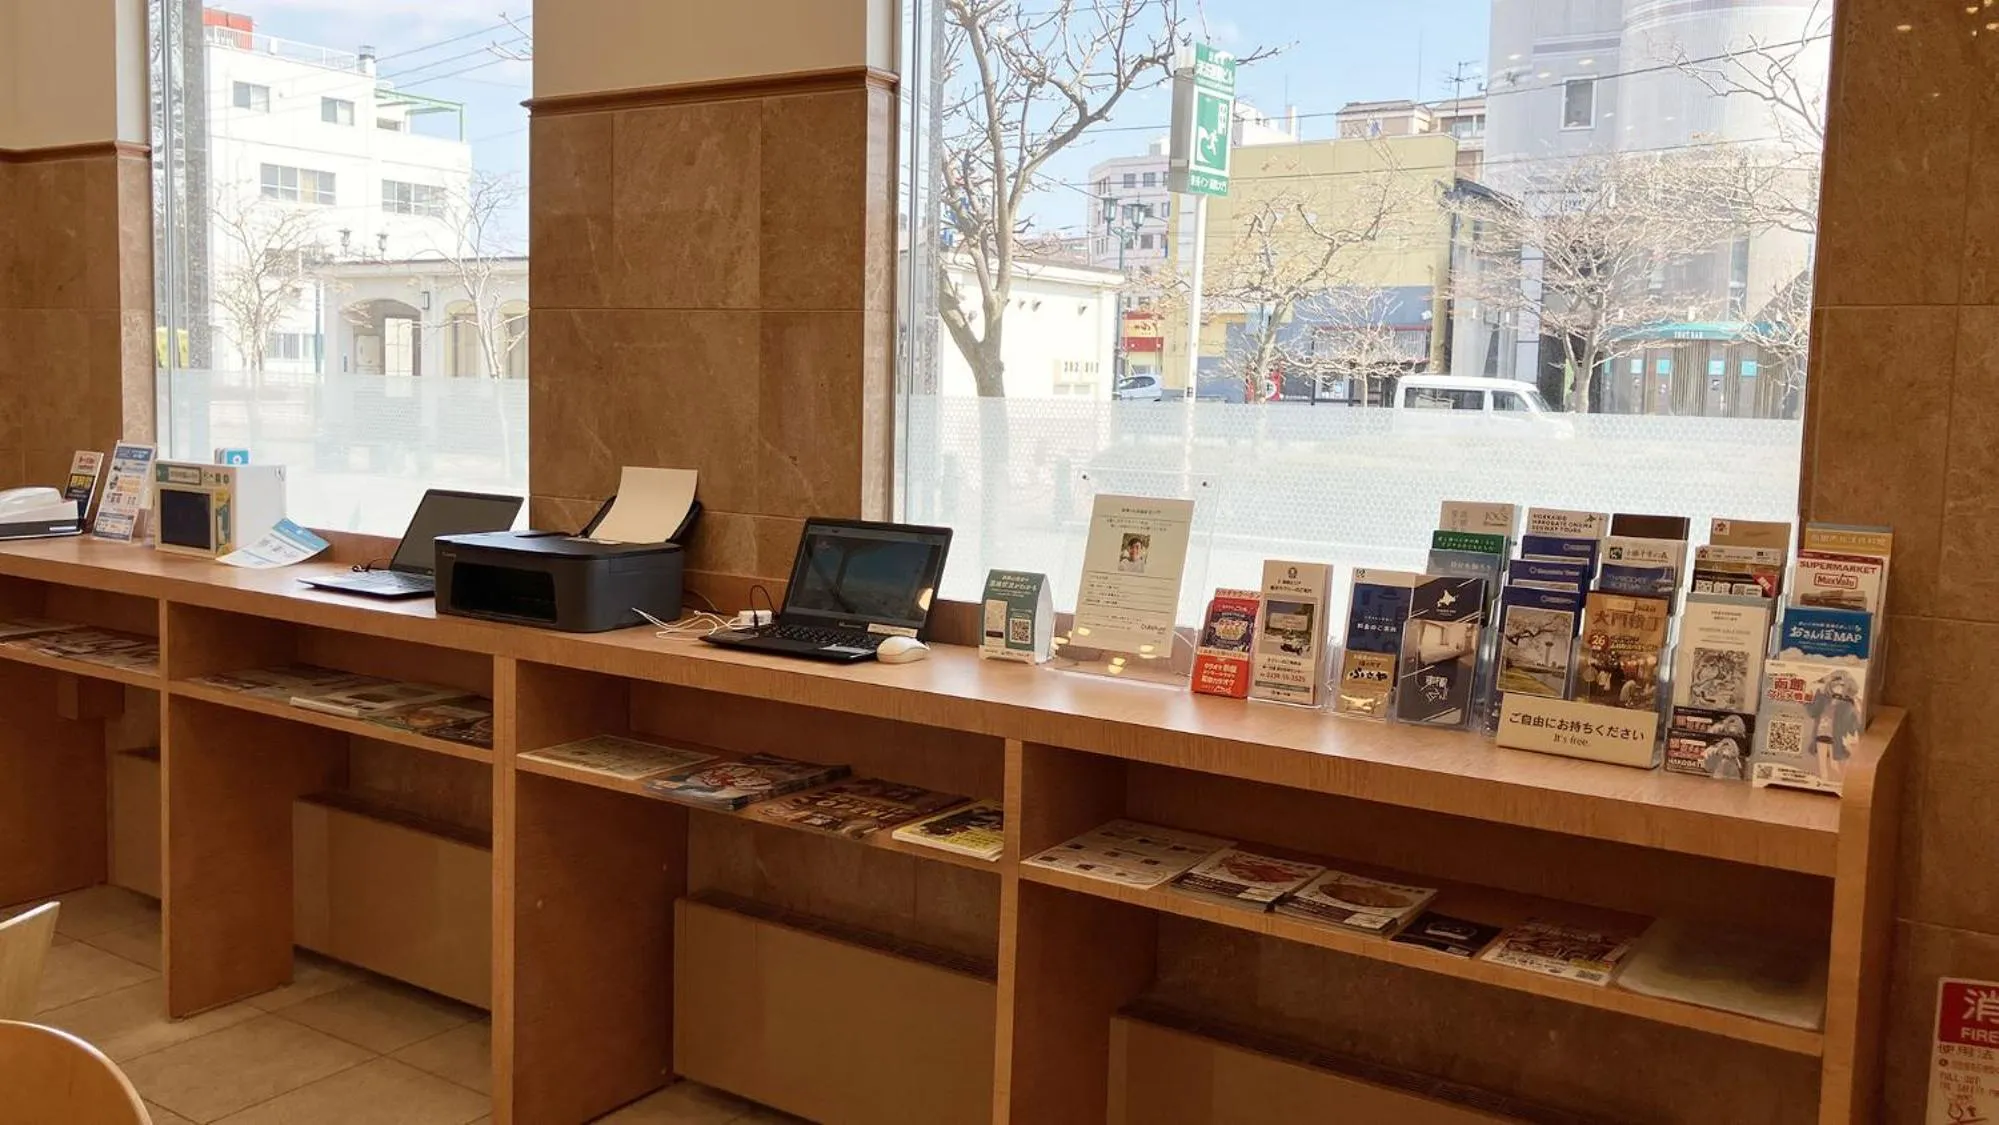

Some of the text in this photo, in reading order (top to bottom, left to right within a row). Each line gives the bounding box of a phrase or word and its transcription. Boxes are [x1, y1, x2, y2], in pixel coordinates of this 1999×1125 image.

[1799, 560, 1877, 575] SUPERMARKET
[1817, 573, 1855, 588] MaxValu
[1592, 634, 1605, 646] 26
[1789, 625, 1862, 643] おさんぽMAP
[1774, 677, 1804, 692] 函館
[1509, 712, 1645, 741] ご自由にお持ちください
[1553, 733, 1589, 747] It's free
[1961, 1026, 1999, 1043] FIRE
